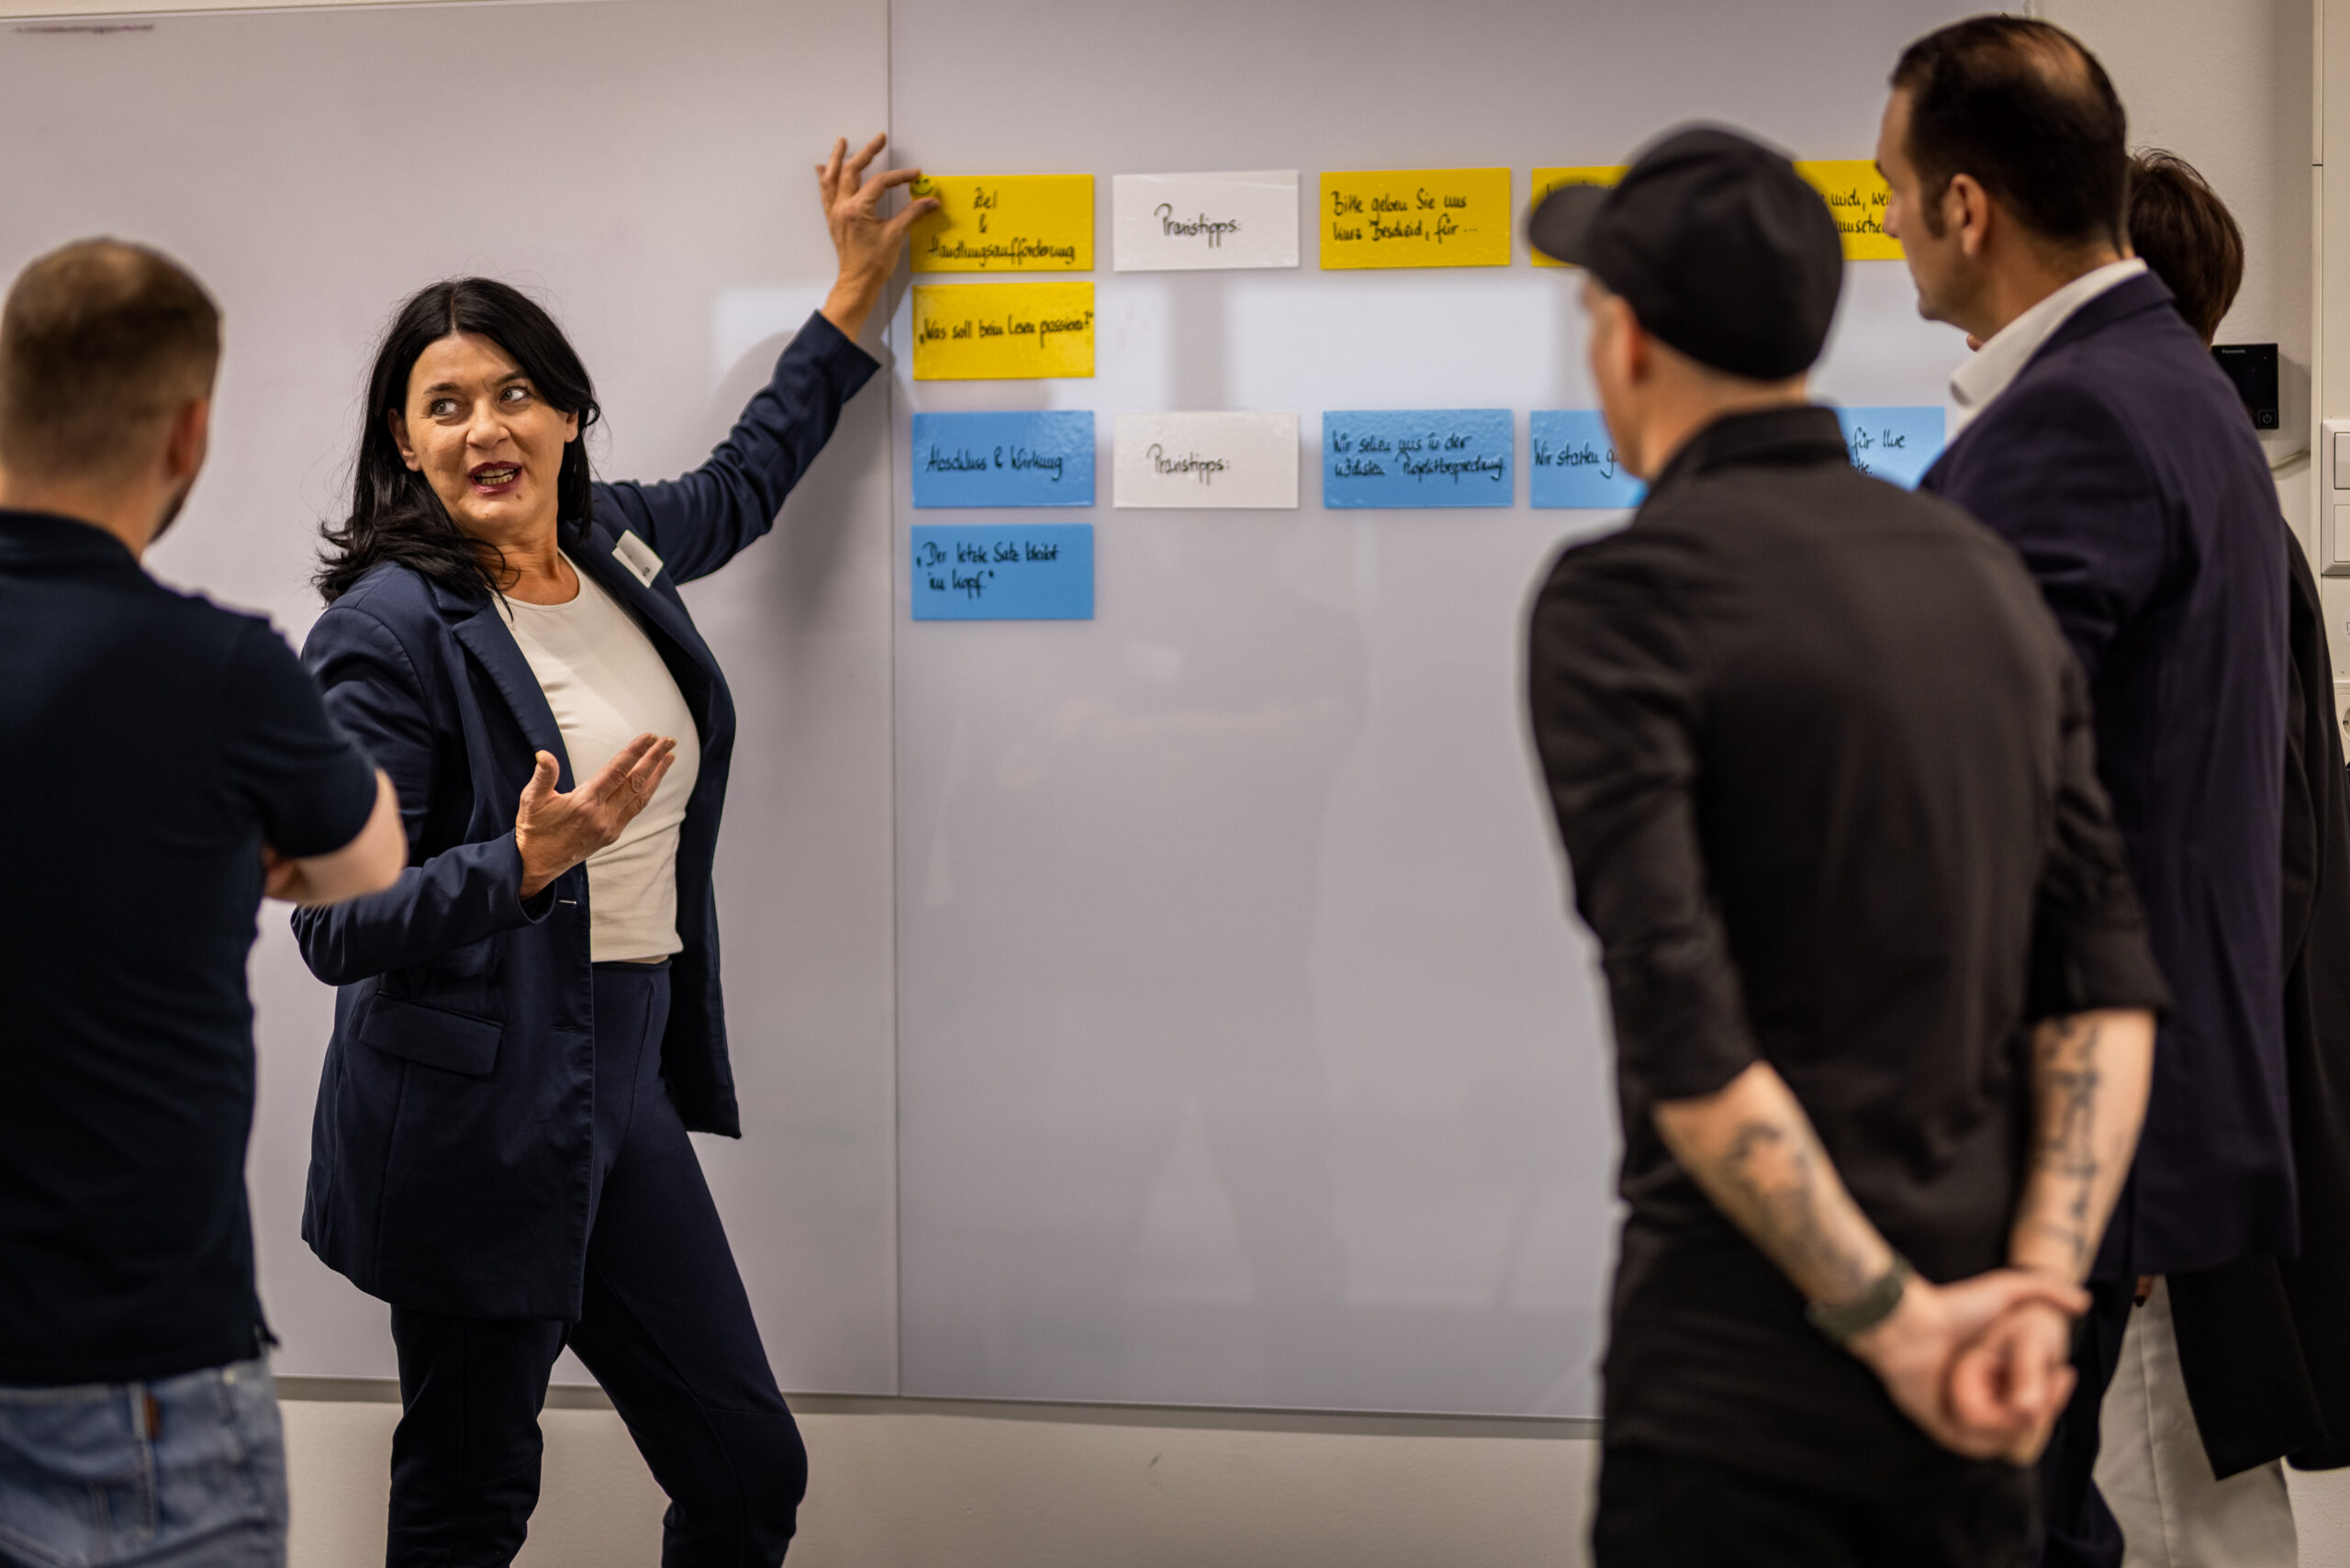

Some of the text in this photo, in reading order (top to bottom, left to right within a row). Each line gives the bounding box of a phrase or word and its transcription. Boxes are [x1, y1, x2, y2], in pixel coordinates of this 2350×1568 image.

[973, 186, 998, 209] Ziel
[1330, 187, 1467, 224] Bitte geben Sie uns
[1434, 213, 1459, 244] für
[927, 236, 1076, 267] Handlungsaufforderung
[952, 319, 973, 340] soll
[979, 319, 1005, 338] beim
[1007, 313, 1035, 335] Lesen
[1333, 430, 1351, 453] Wir
[1444, 432, 1472, 451] der
[1534, 437, 1552, 466] Wir
[1556, 441, 1600, 466] starten
[1851, 426, 1875, 461] für
[924, 444, 1064, 482] Abschluss & Wirkung
[956, 541, 988, 564] letzte
[992, 541, 1020, 563] Satz
[1025, 540, 1060, 562] bleibt
